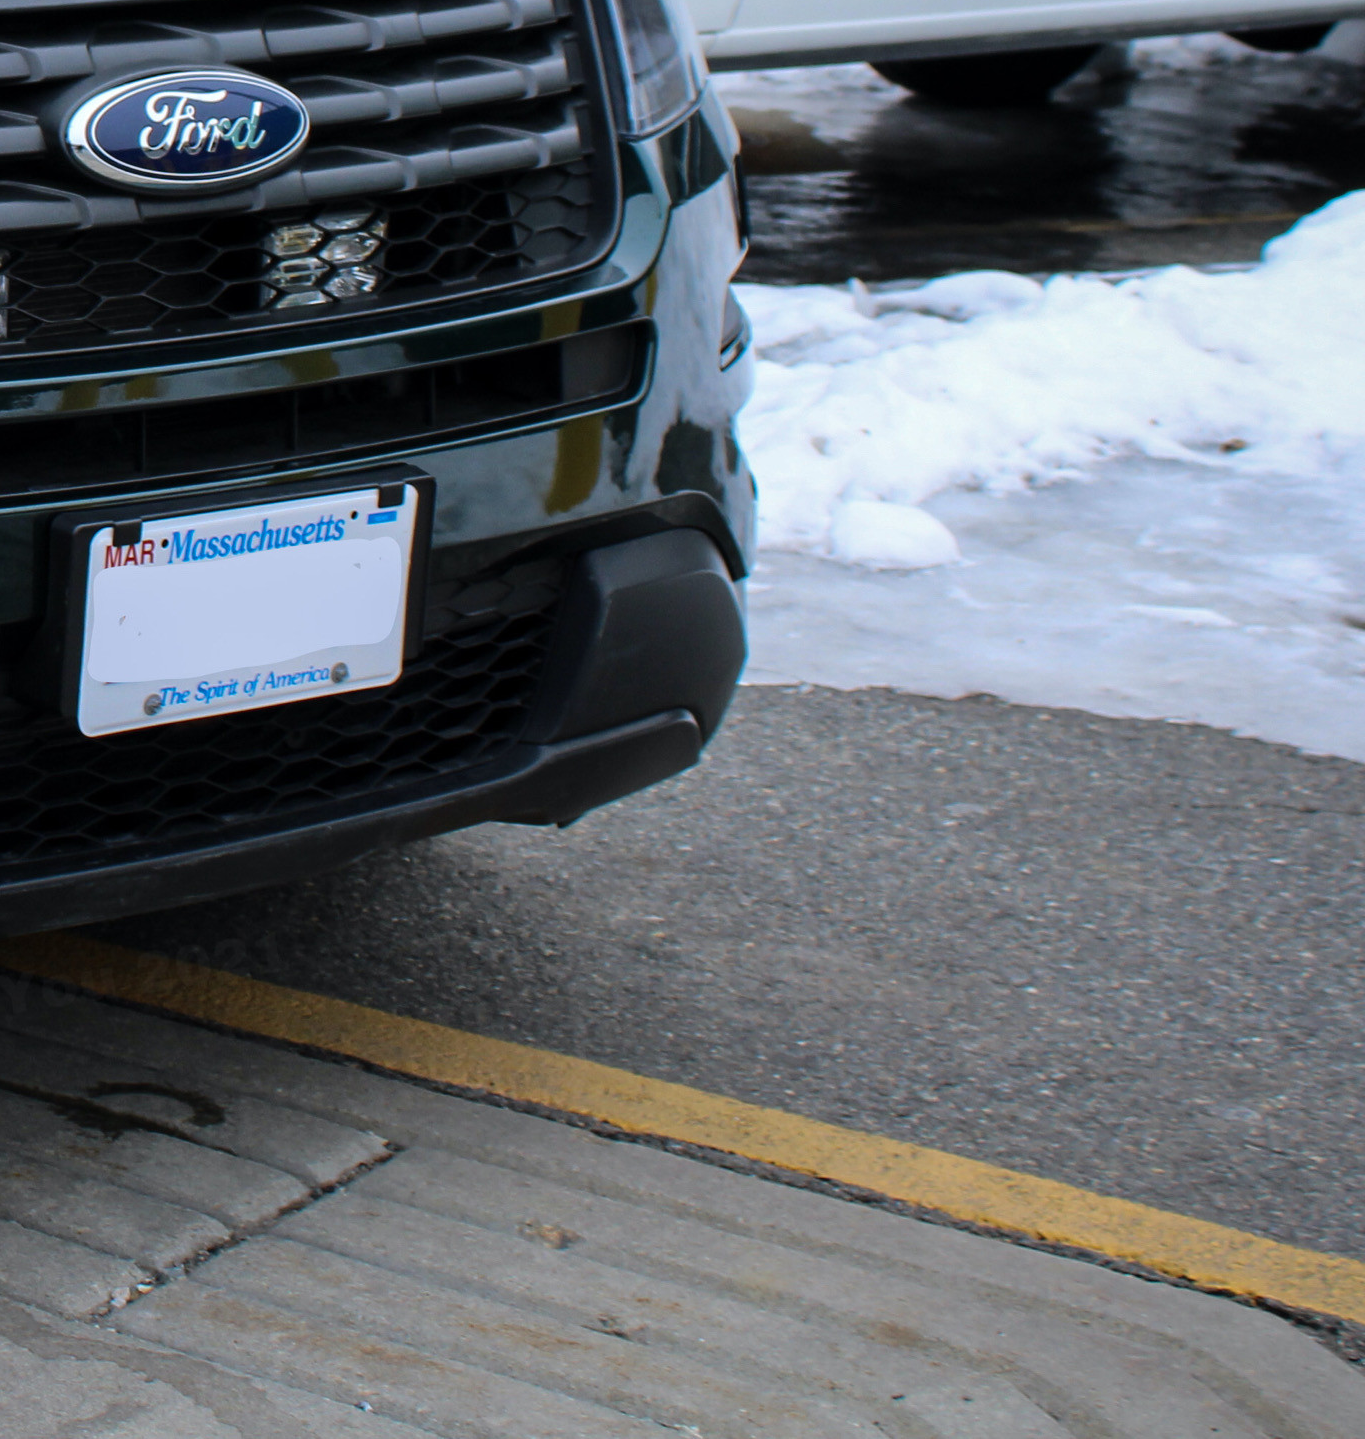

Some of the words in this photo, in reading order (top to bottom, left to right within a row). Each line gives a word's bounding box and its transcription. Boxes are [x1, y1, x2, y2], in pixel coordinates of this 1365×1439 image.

[139, 89, 266, 159] Ford
[104, 538, 155, 569] MAR
[167, 515, 345, 564] Massachusetts
[160, 685, 190, 708] The
[196, 678, 240, 705] Spirit
[244, 674, 260, 697] of
[262, 666, 329, 691] America
